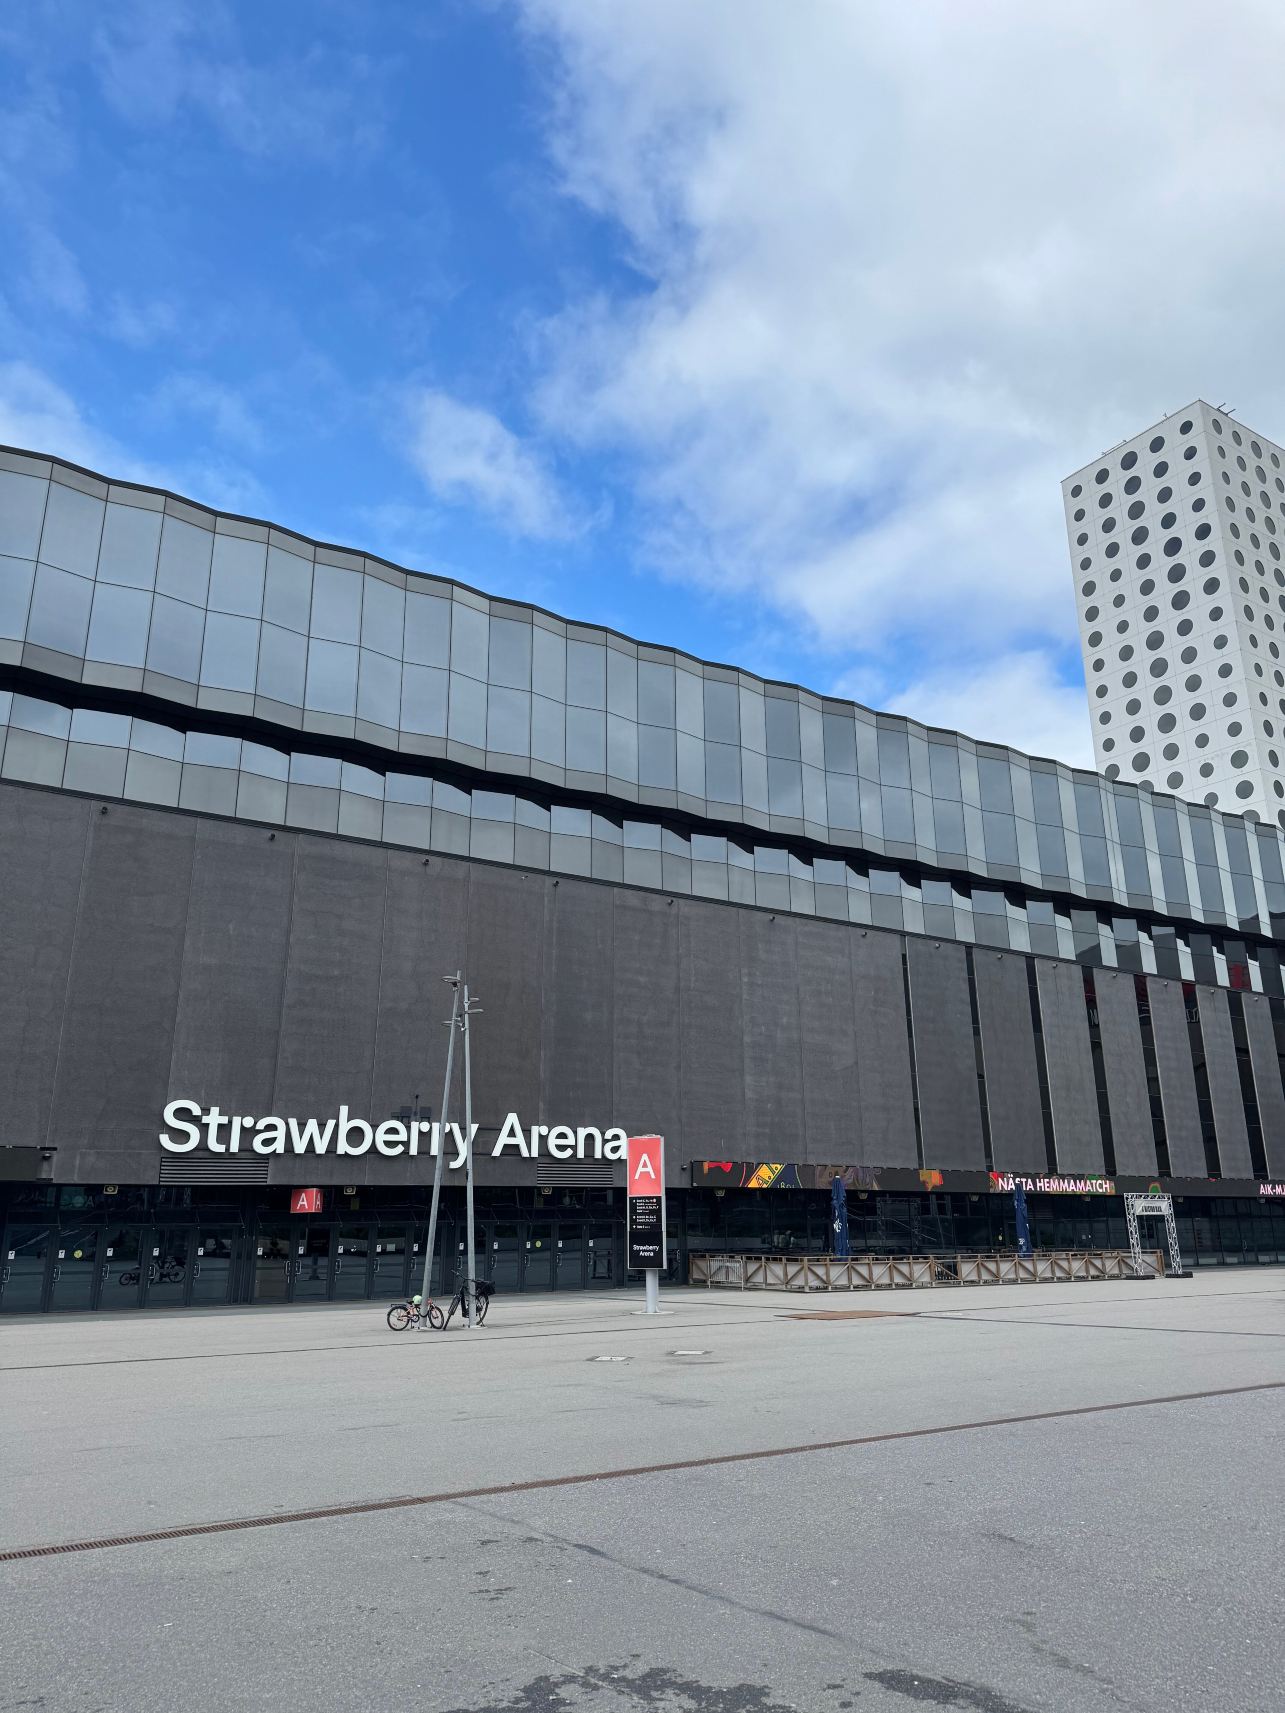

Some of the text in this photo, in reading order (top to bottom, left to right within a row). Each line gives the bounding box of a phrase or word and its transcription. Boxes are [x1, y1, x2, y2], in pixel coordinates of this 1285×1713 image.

[159, 1099, 627, 1169] Strawberry Arena
[634, 1153, 656, 1180] A
[998, 1173, 1111, 1193] NÄTA HEMMAMATCH
[296, 1192, 308, 1209] A
[316, 1193, 321, 1209] A
[633, 1244, 659, 1252] Strawberry
